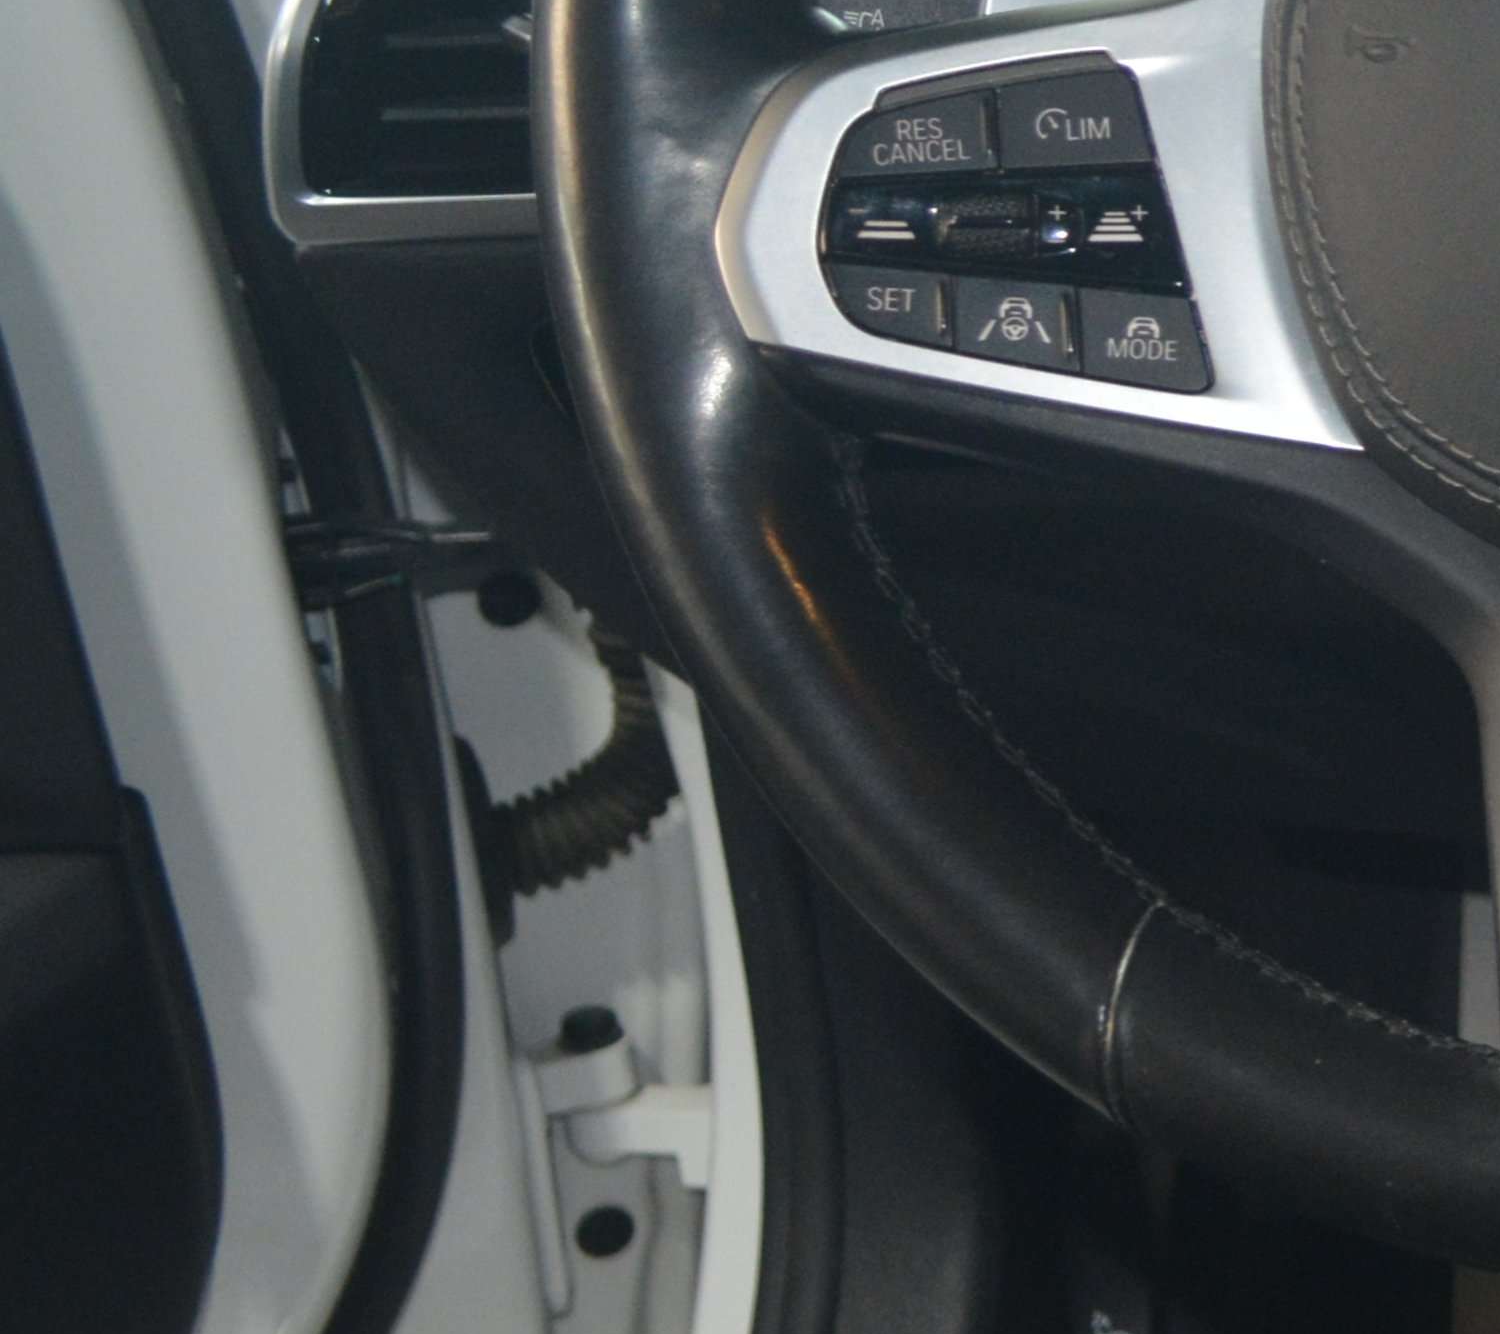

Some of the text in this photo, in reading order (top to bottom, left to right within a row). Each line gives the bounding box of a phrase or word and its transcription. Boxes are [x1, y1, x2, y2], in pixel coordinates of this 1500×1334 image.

[896, 118, 942, 141] RES
[1066, 117, 1111, 142] LIM
[873, 141, 971, 166] CANCEL
[867, 287, 916, 313] SET
[1106, 338, 1178, 362] MODE
